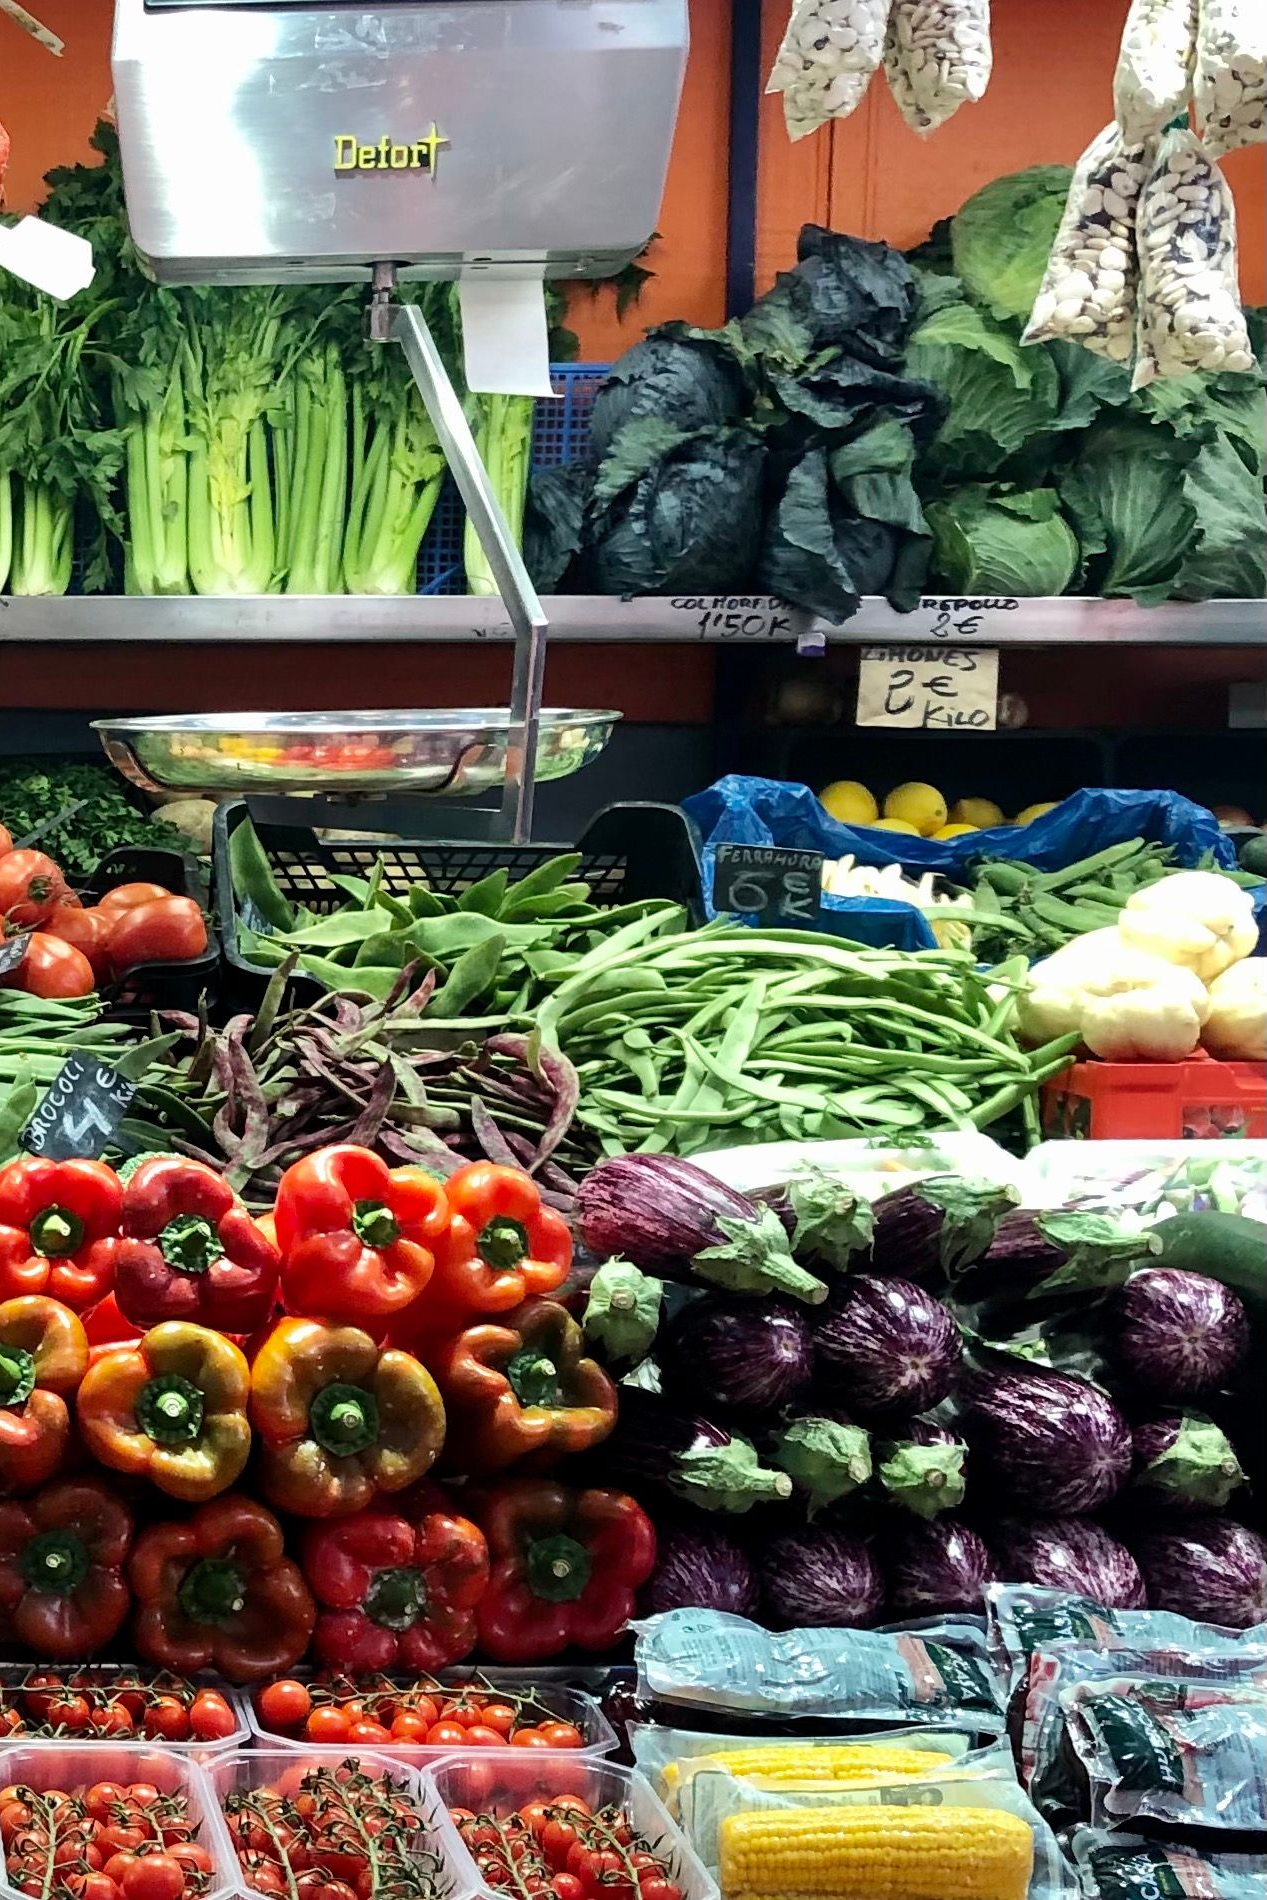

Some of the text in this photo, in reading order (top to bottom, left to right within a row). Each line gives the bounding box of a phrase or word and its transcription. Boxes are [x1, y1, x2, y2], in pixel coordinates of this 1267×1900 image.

[884, 669, 959, 715] 2 €
[728, 871, 811, 913] 6 €
[779, 892, 816, 920] K
[61, 1067, 118, 1141] 4 €
